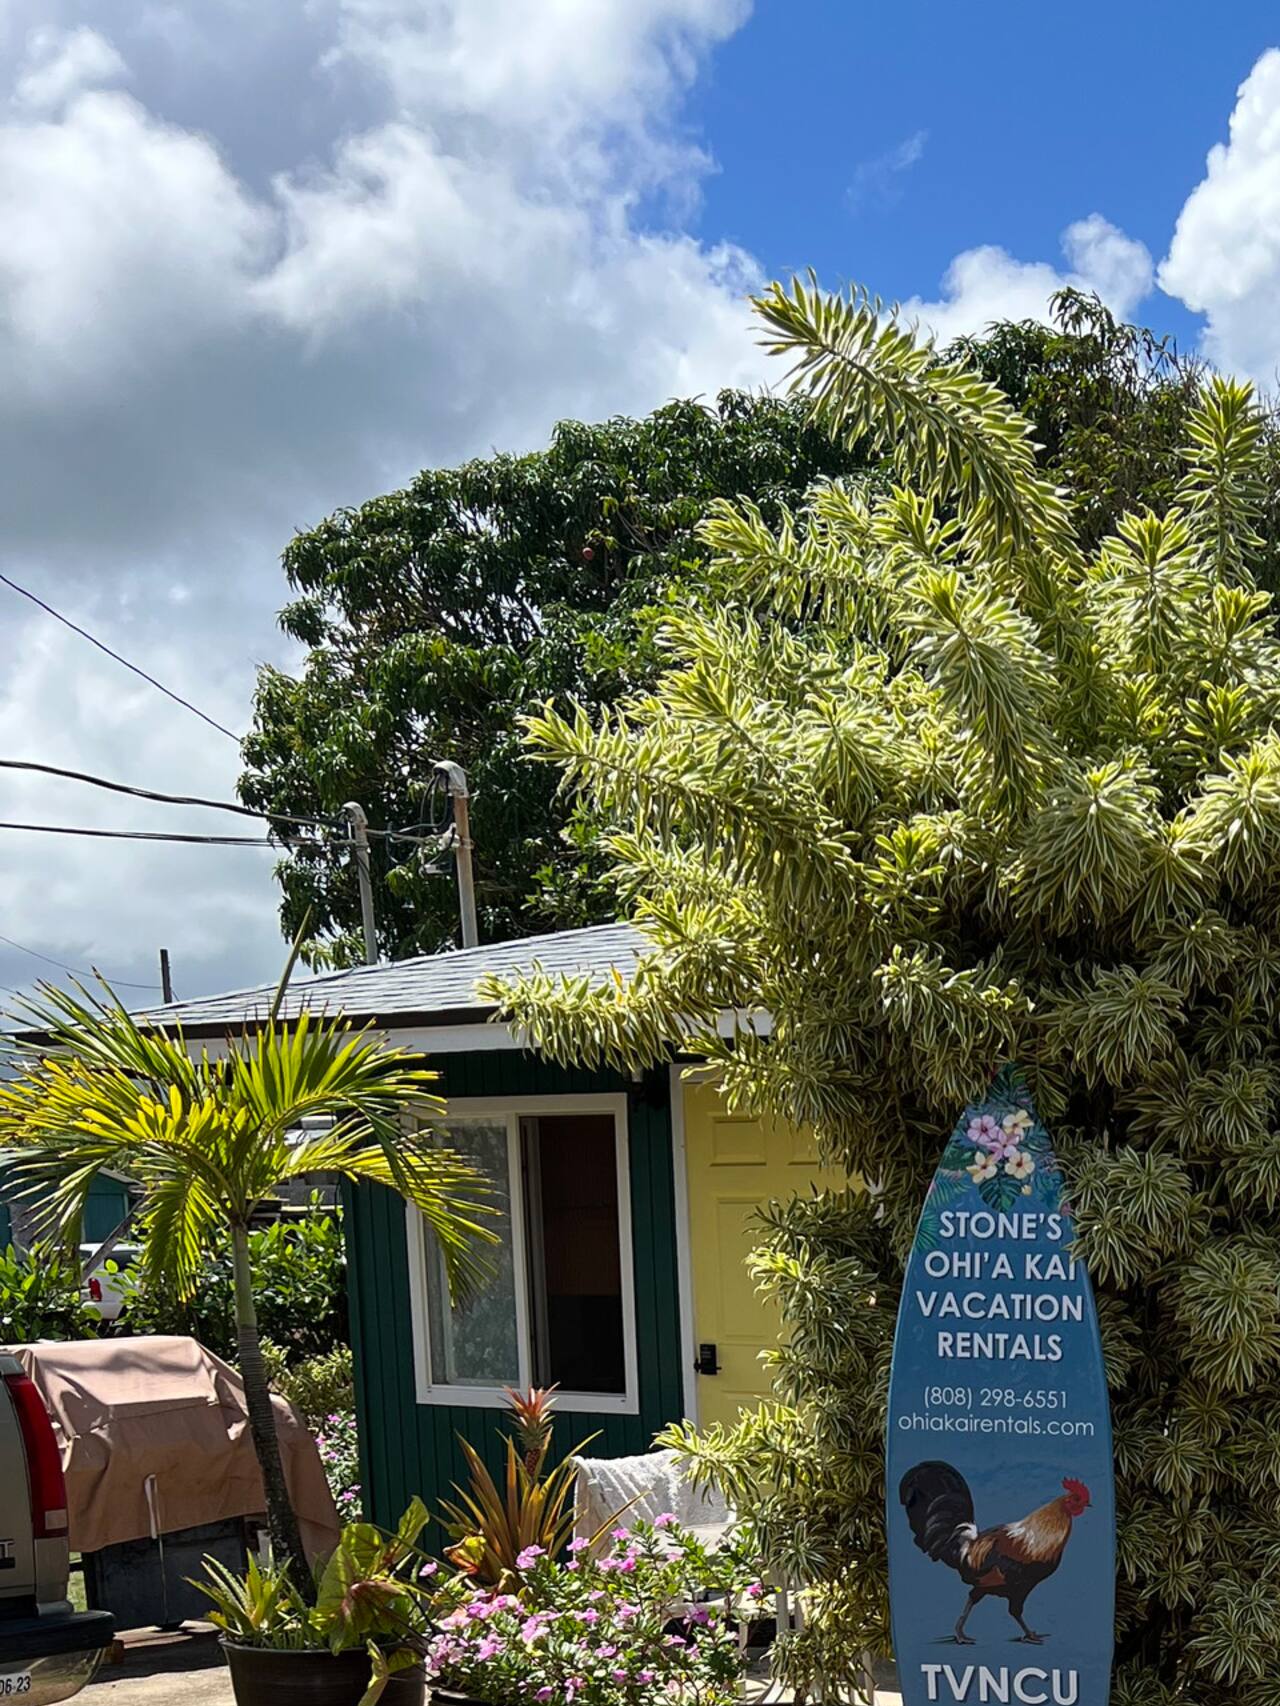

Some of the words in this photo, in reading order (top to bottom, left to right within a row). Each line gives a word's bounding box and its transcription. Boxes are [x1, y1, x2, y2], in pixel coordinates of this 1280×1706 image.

[939, 1211, 1062, 1240] STONE'S
[924, 1251, 1014, 1279] OHI'A
[1025, 1254, 1076, 1281] KAI
[916, 1290, 1083, 1321] VACATION
[938, 1332, 1062, 1361] RENTALS
[924, 1386, 972, 1410] (808)
[980, 1388, 1067, 1409] 298-6551
[898, 1413, 1094, 1436] ohiakairentals.com
[921, 1664, 1078, 1706] TVNCU
